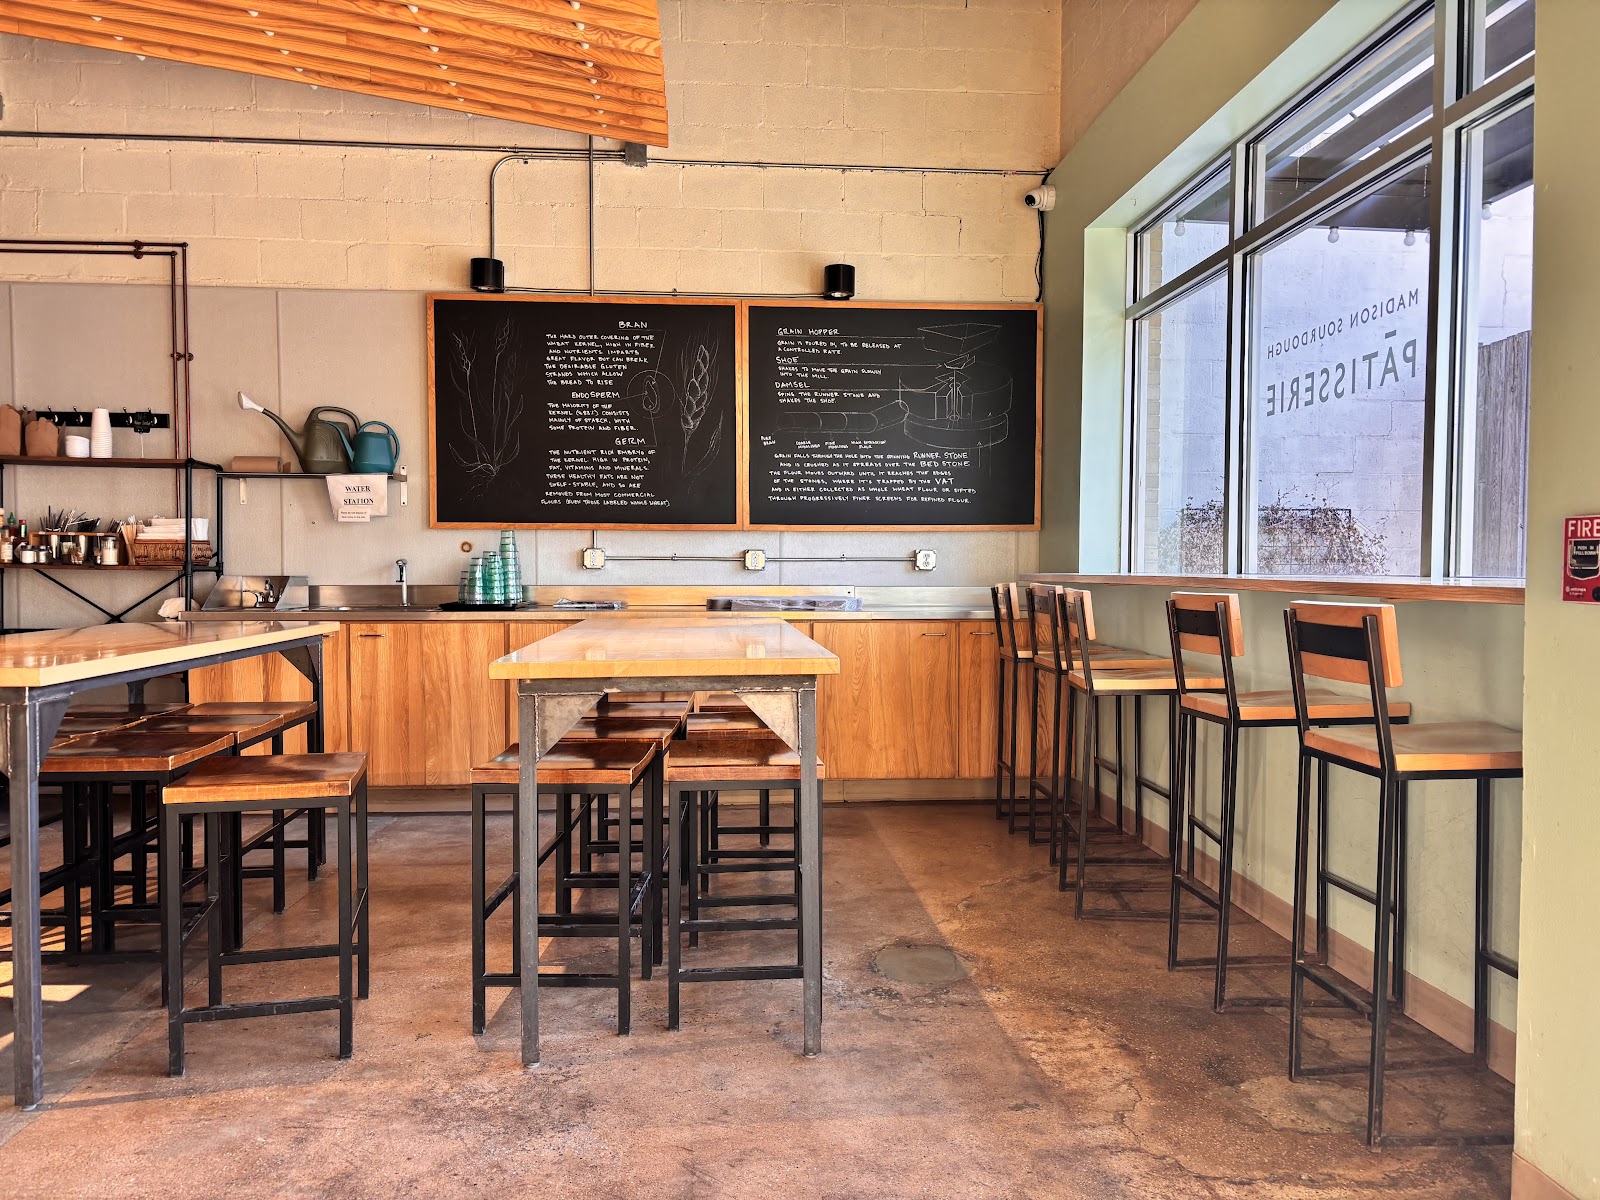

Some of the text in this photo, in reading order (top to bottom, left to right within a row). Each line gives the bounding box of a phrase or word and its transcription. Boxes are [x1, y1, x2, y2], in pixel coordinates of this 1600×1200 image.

[778, 328, 803, 336] GRAIN
[776, 356, 799, 365] SHOE
[572, 391, 620, 399] ENDOSPERM
[615, 437, 646, 445] GERM
[913, 451, 941, 459] RUNNER
[1568, 519, 1600, 537] FIRE
